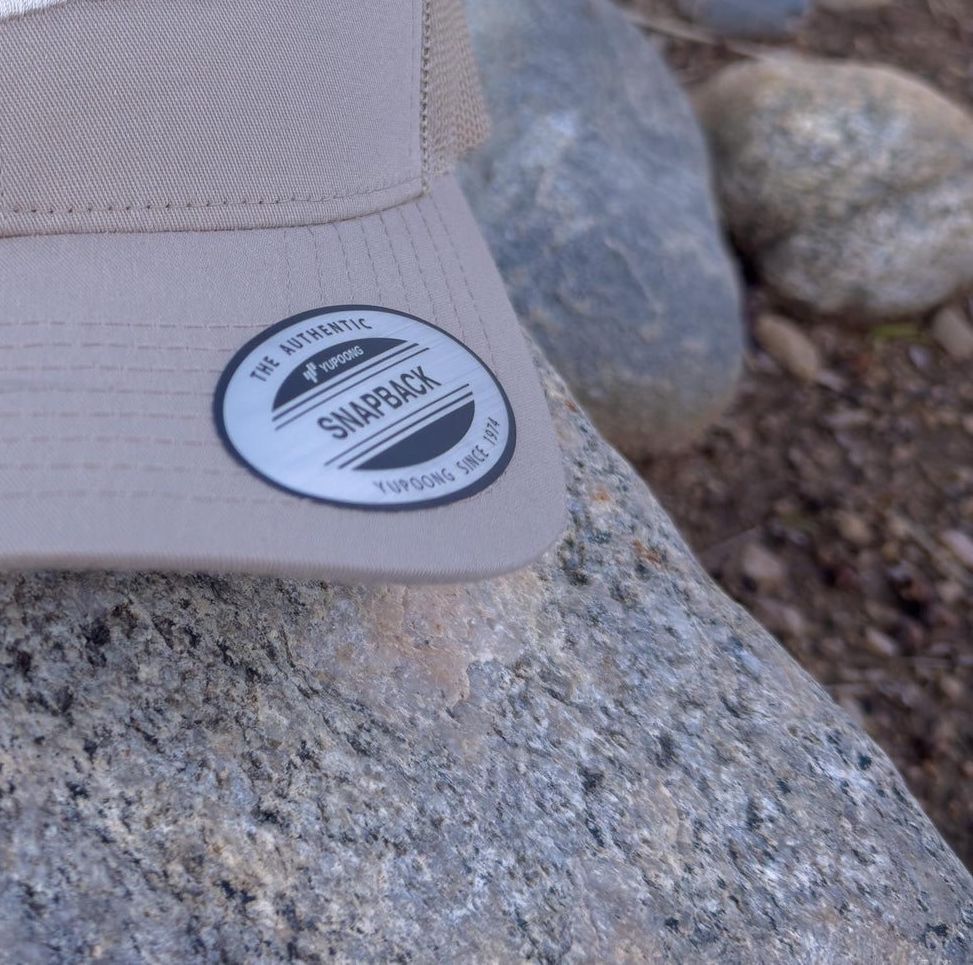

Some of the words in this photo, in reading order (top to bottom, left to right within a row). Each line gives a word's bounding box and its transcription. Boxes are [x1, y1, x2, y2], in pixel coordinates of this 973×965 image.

[249, 352, 281, 383] THE
[279, 317, 373, 354] AUTHENTIC
[318, 344, 365, 374] YUPOONG
[316, 364, 442, 441] SNAPBACK
[373, 468, 455, 495] YUPOONG
[456, 444, 490, 475] SINCE
[483, 416, 501, 447] 1974
